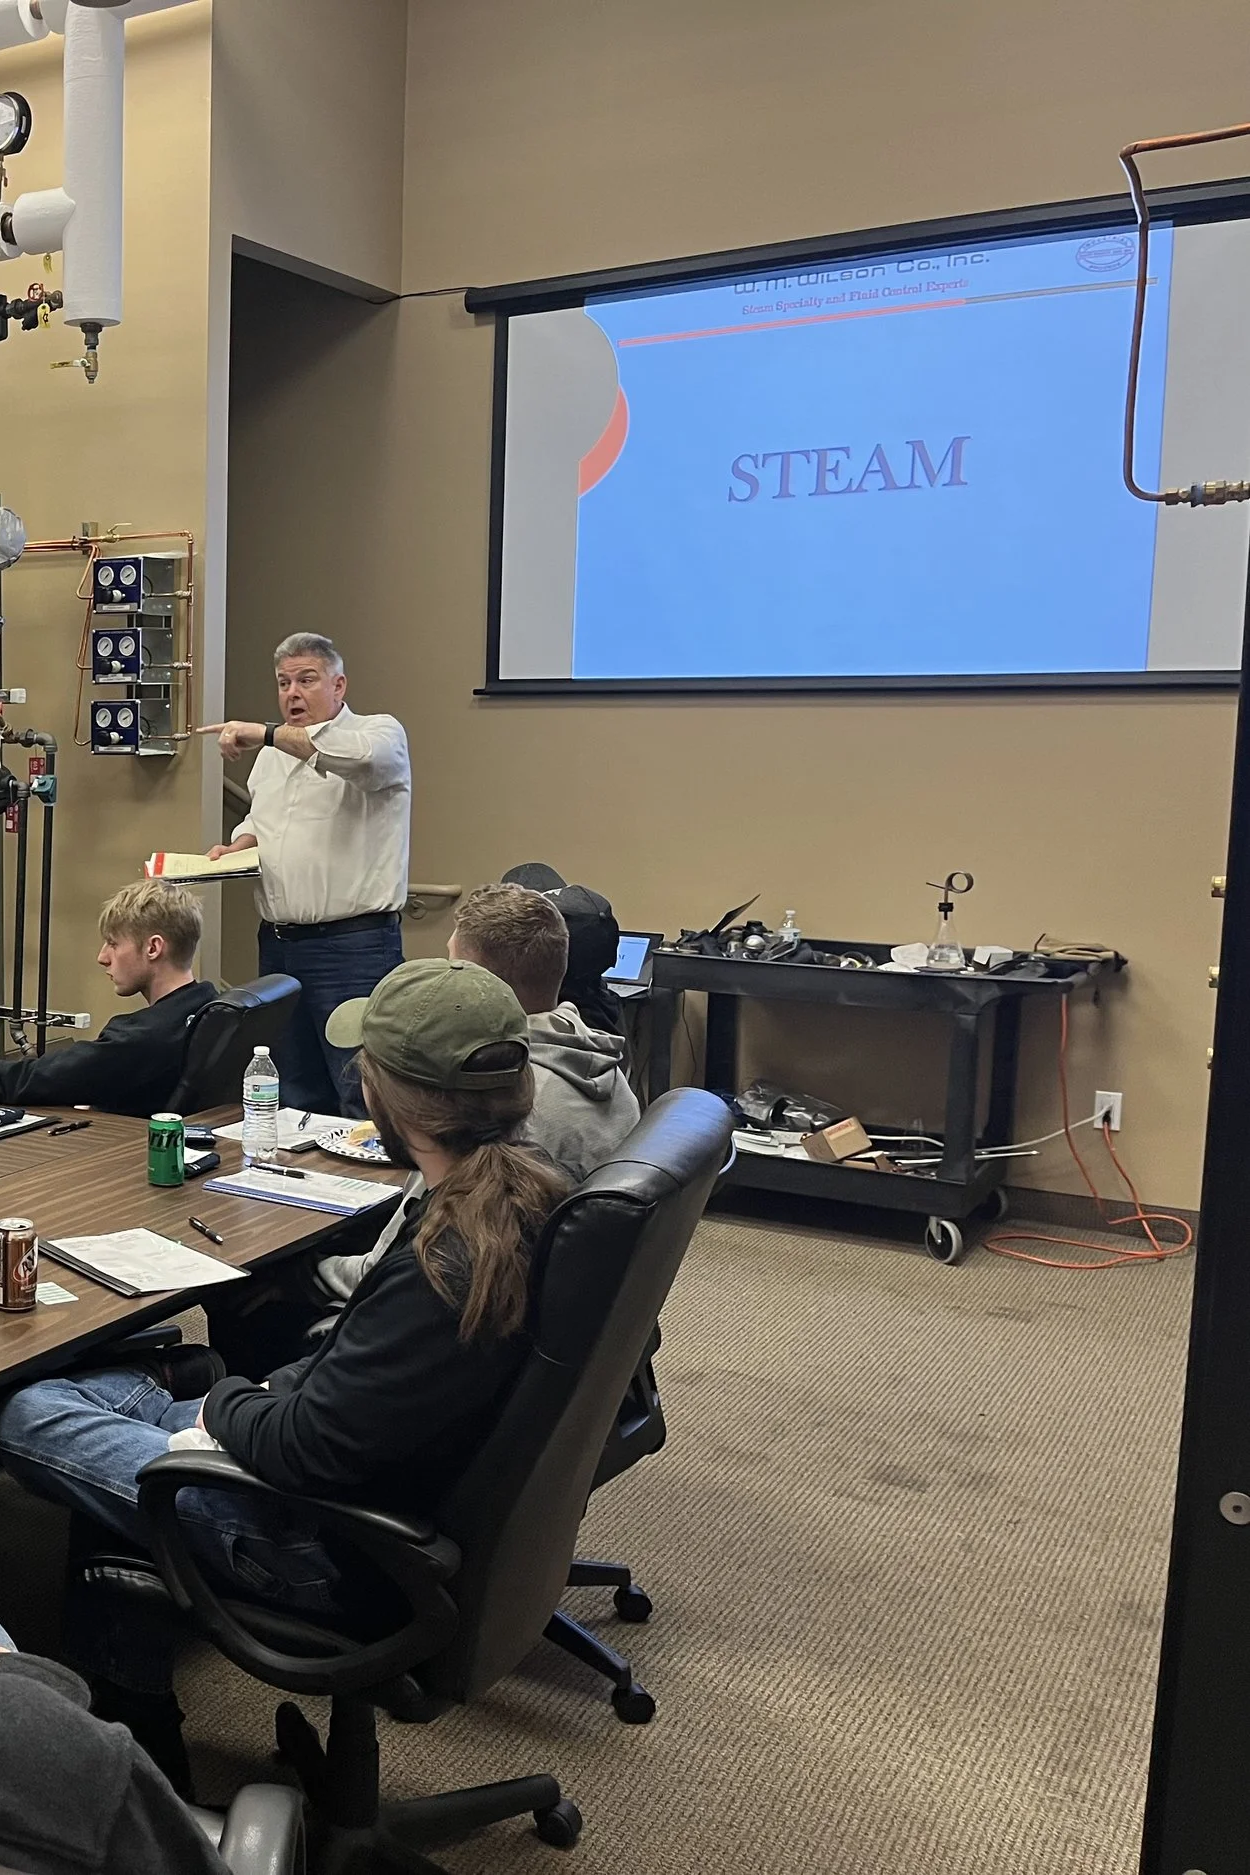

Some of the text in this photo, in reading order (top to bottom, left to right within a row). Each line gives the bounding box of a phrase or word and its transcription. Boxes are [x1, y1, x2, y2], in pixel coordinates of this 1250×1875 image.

[742, 279, 969, 315] Steam Specialty and Fluid Control Experts
[727, 435, 972, 503] STEAM
